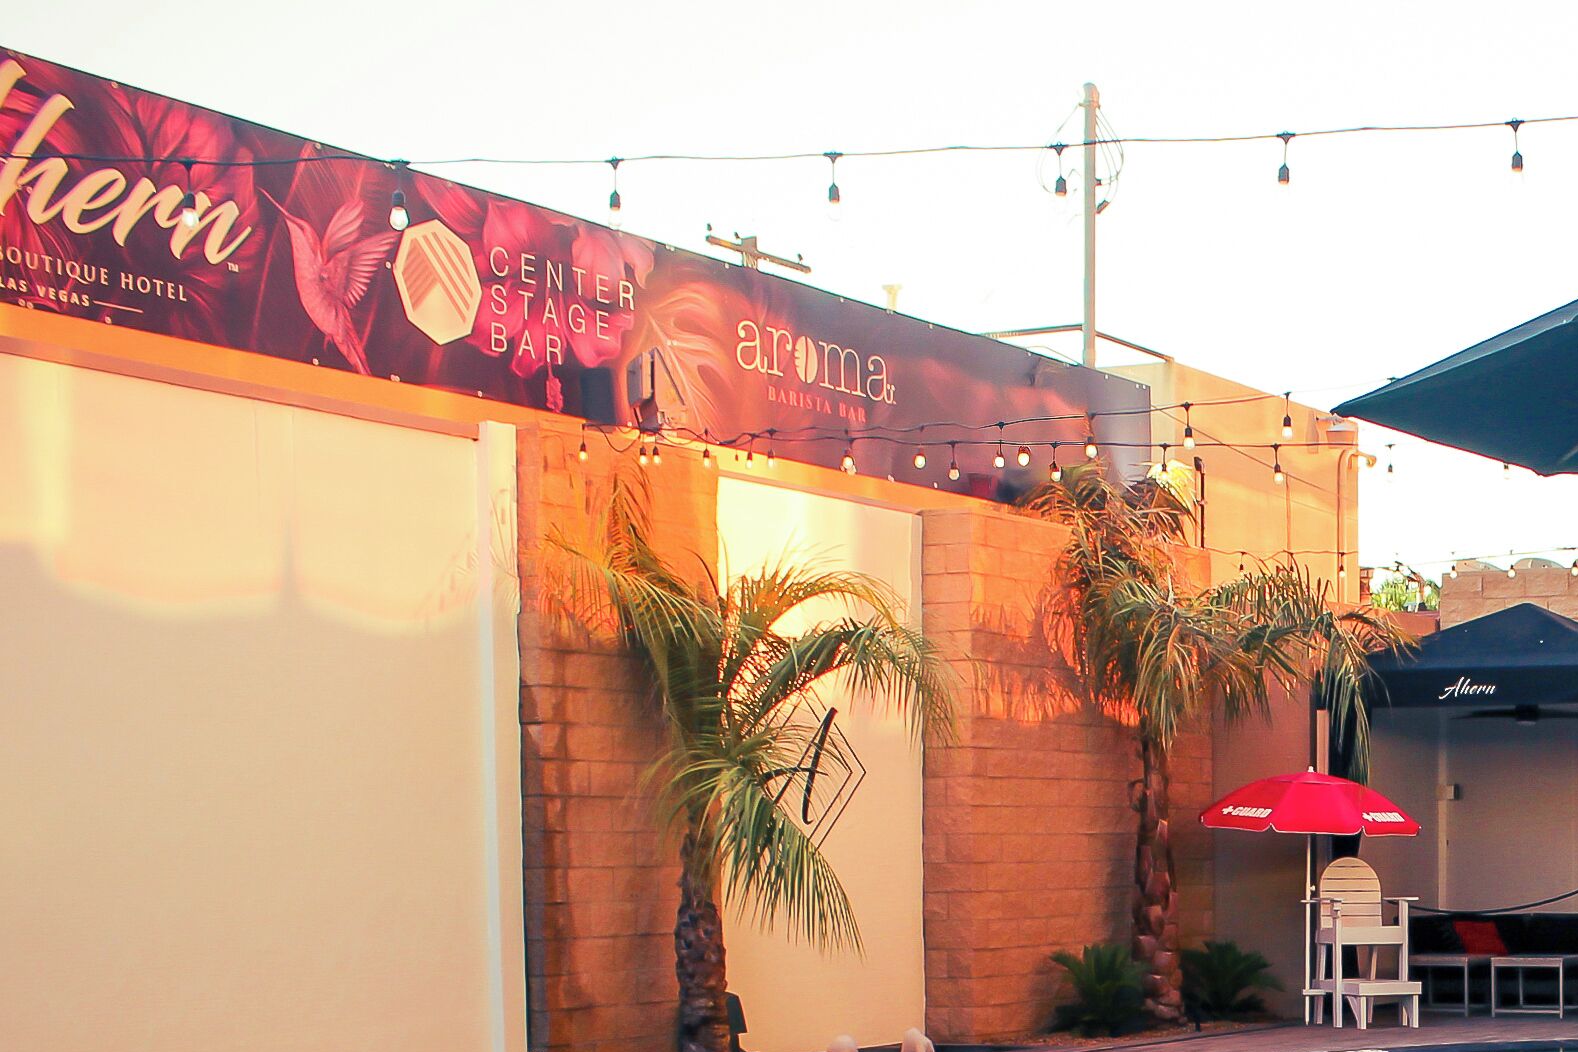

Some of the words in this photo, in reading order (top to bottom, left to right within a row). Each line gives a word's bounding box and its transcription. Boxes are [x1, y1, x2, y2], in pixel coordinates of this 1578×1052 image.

[0, 59, 252, 265] hern
[0, 276, 28, 292] LAS
[36, 284, 90, 307] VEGAS
[120, 272, 187, 302] HOTEL
[489, 246, 635, 311] CENTER
[490, 284, 610, 340] STAGE
[491, 321, 562, 365] BAR
[767, 385, 832, 414] BARISTA
[838, 402, 867, 423] BAR
[1438, 676, 1496, 700] Ahern
